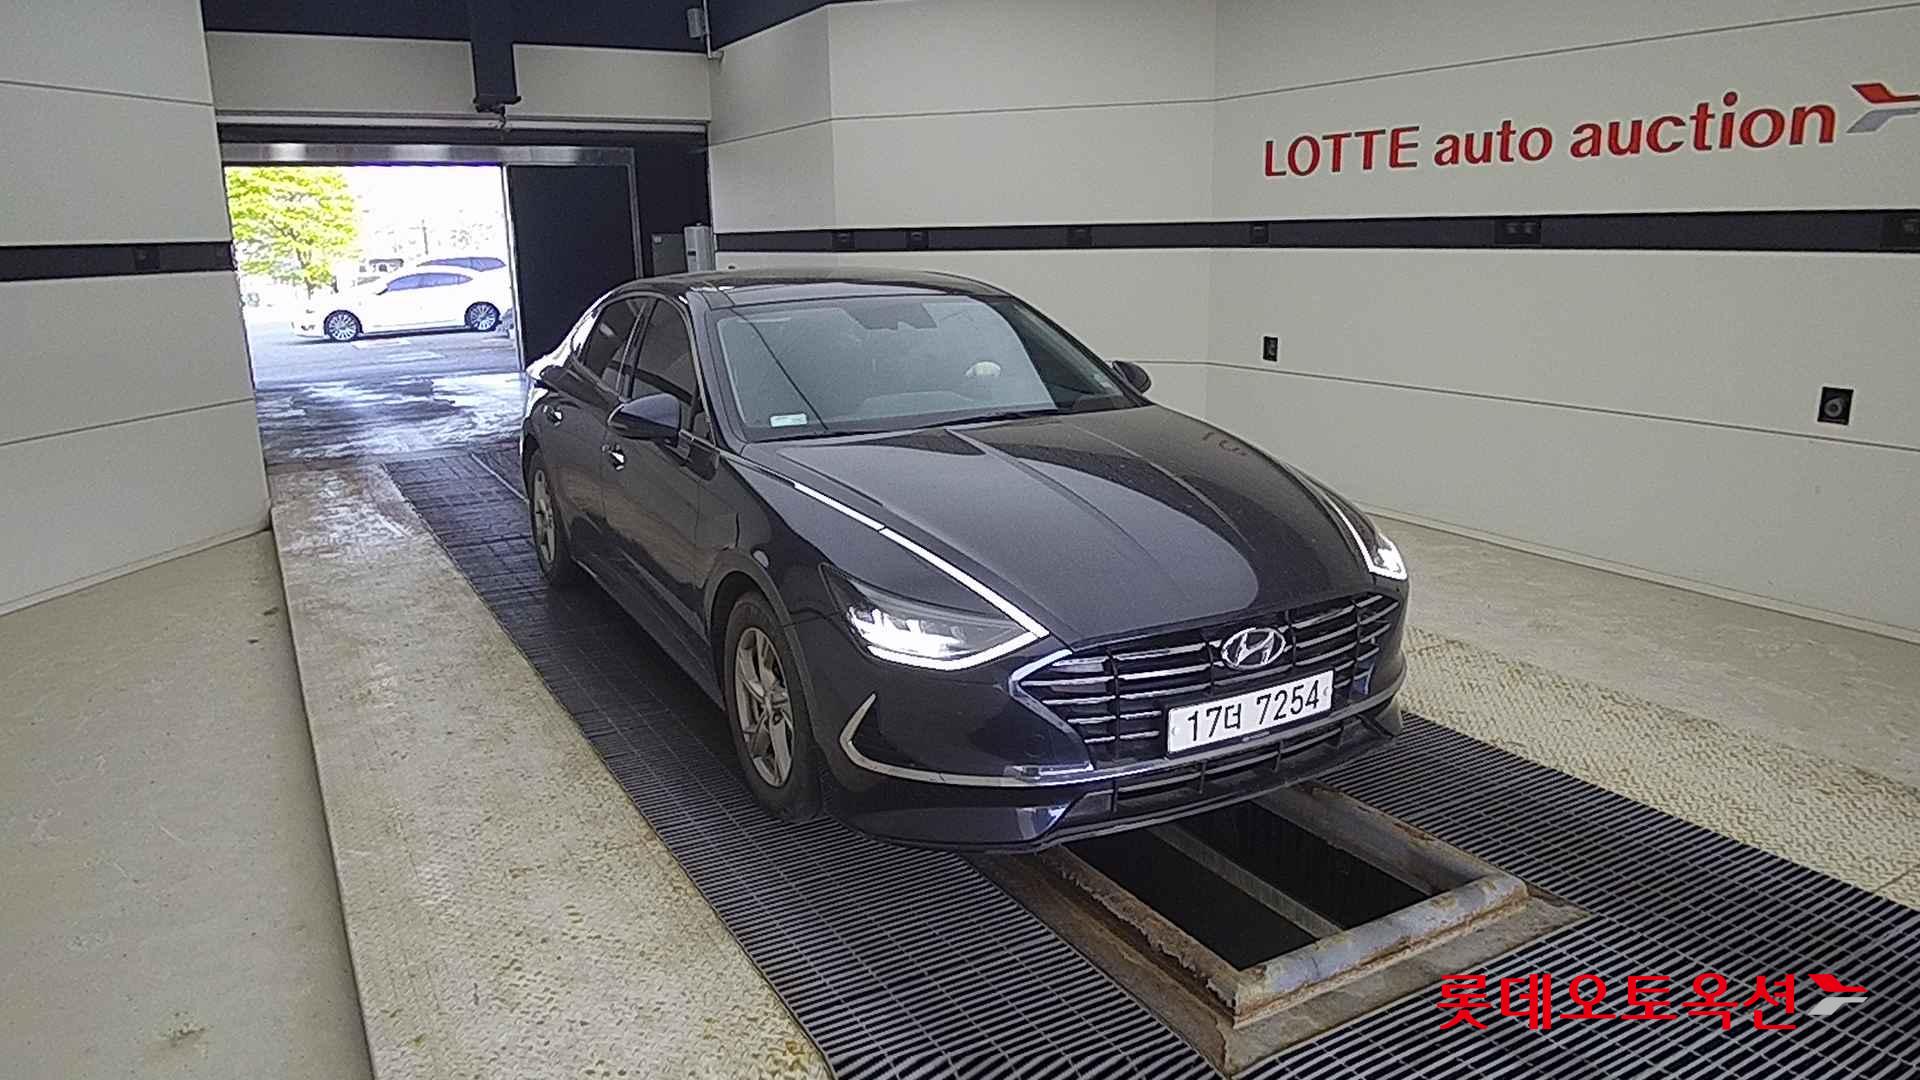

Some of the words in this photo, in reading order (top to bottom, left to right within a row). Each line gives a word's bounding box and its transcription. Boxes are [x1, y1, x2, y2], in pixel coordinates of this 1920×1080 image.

[1265, 126, 1419, 176] LOTTE
[1434, 120, 1552, 166] auto
[1570, 92, 1836, 158] auction
[1188, 703, 1242, 742] 17더
[1256, 680, 1320, 725] 7254
